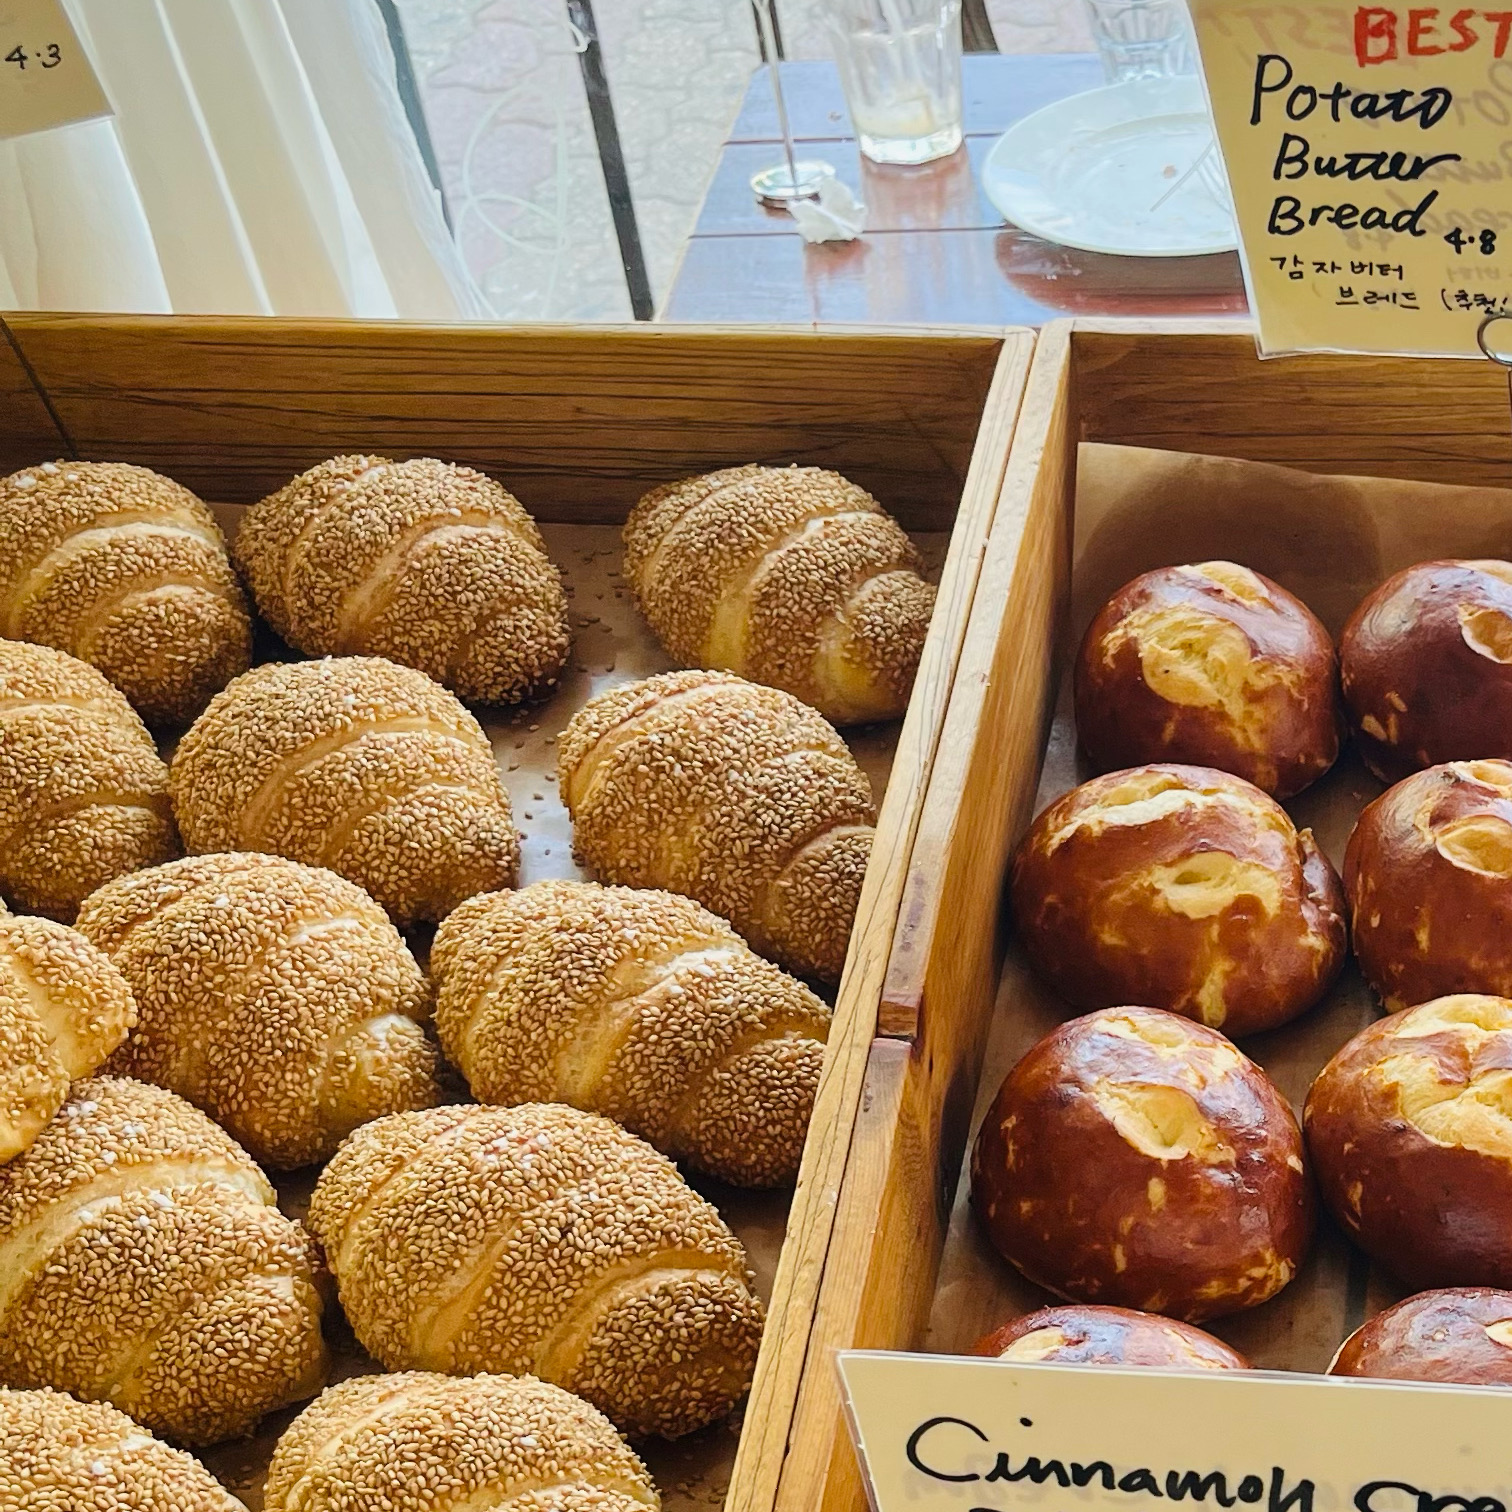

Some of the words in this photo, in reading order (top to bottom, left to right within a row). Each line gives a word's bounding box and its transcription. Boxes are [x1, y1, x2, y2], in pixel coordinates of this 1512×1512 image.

[1249, 54, 1453, 130] Potato
[1273, 132, 1462, 182] Butter
[1267, 189, 1439, 237] Bread
